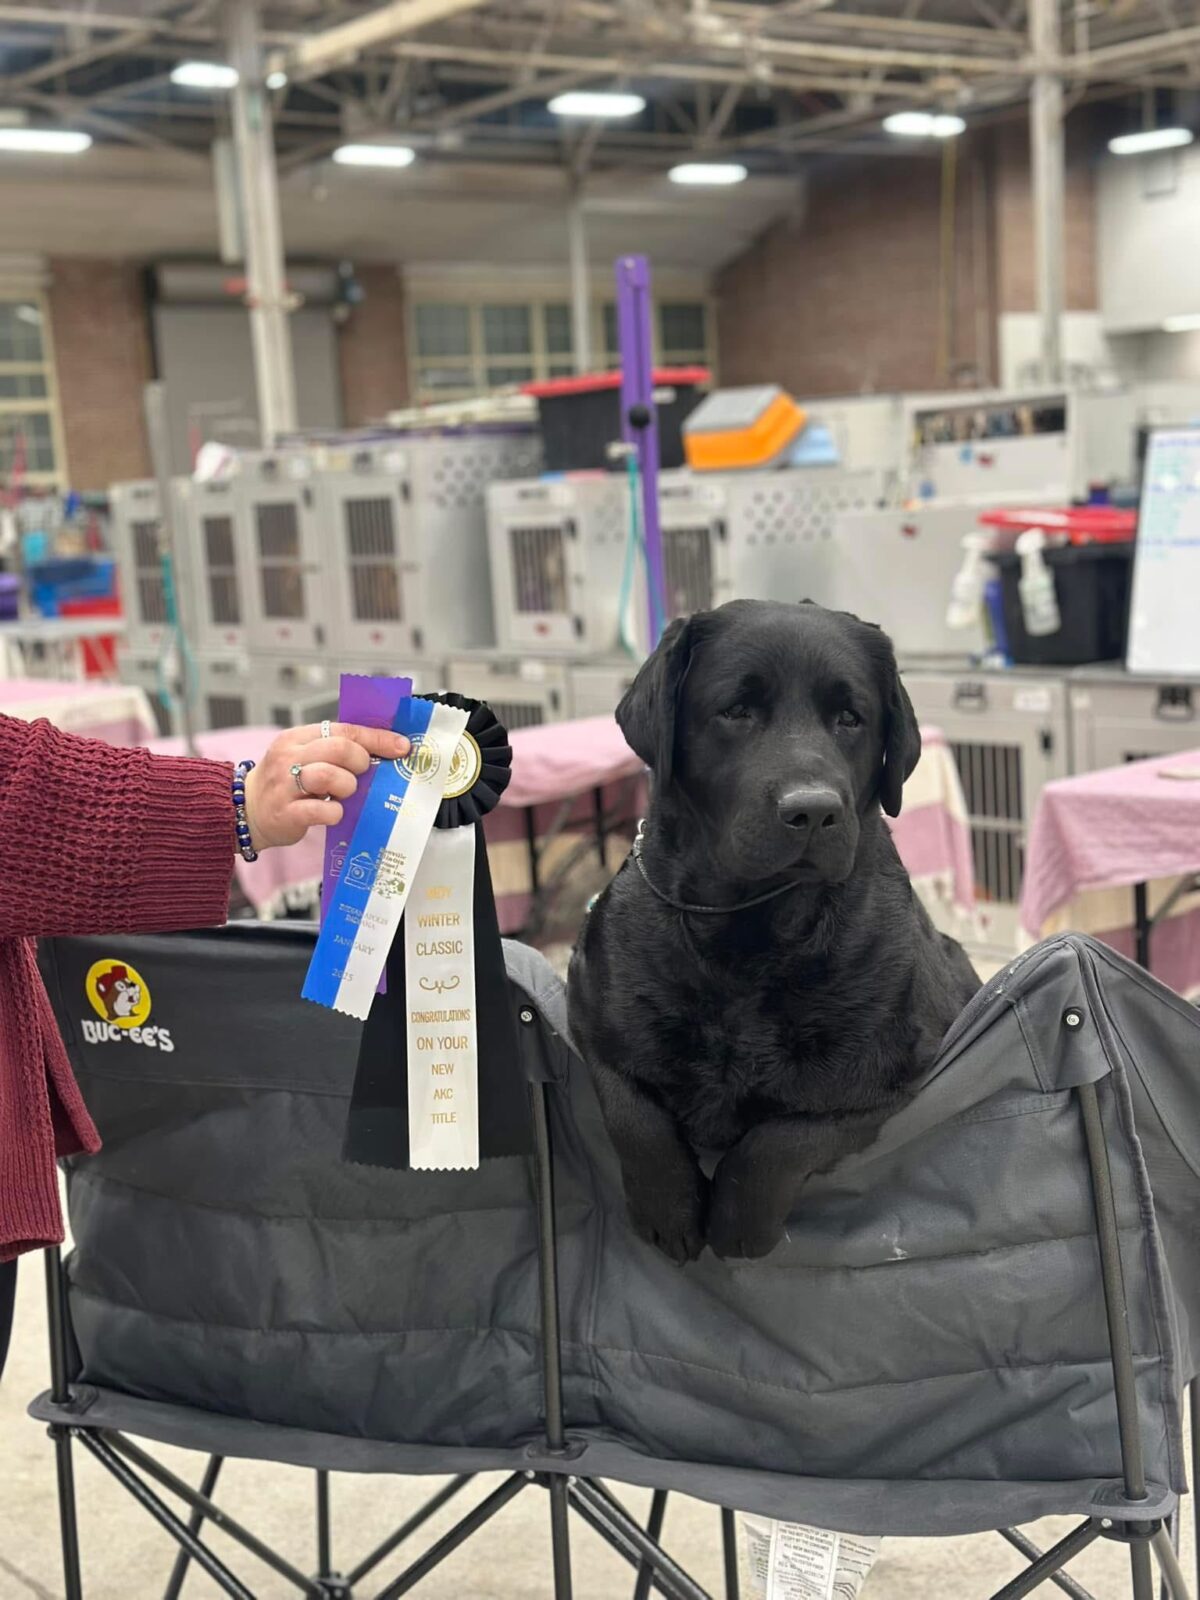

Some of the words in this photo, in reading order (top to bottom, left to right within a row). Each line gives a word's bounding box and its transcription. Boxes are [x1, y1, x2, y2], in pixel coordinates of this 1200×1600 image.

[417, 912, 460, 928] WINTER
[416, 940, 463, 956] CLASSIC
[411, 1009, 471, 1023] CONGRATULATIONS
[416, 1036, 433, 1050] ON
[437, 1036, 468, 1050] YOUR
[431, 1063, 454, 1075] NEW
[433, 1087, 453, 1100] AKC
[431, 1112, 457, 1124] TITLE
